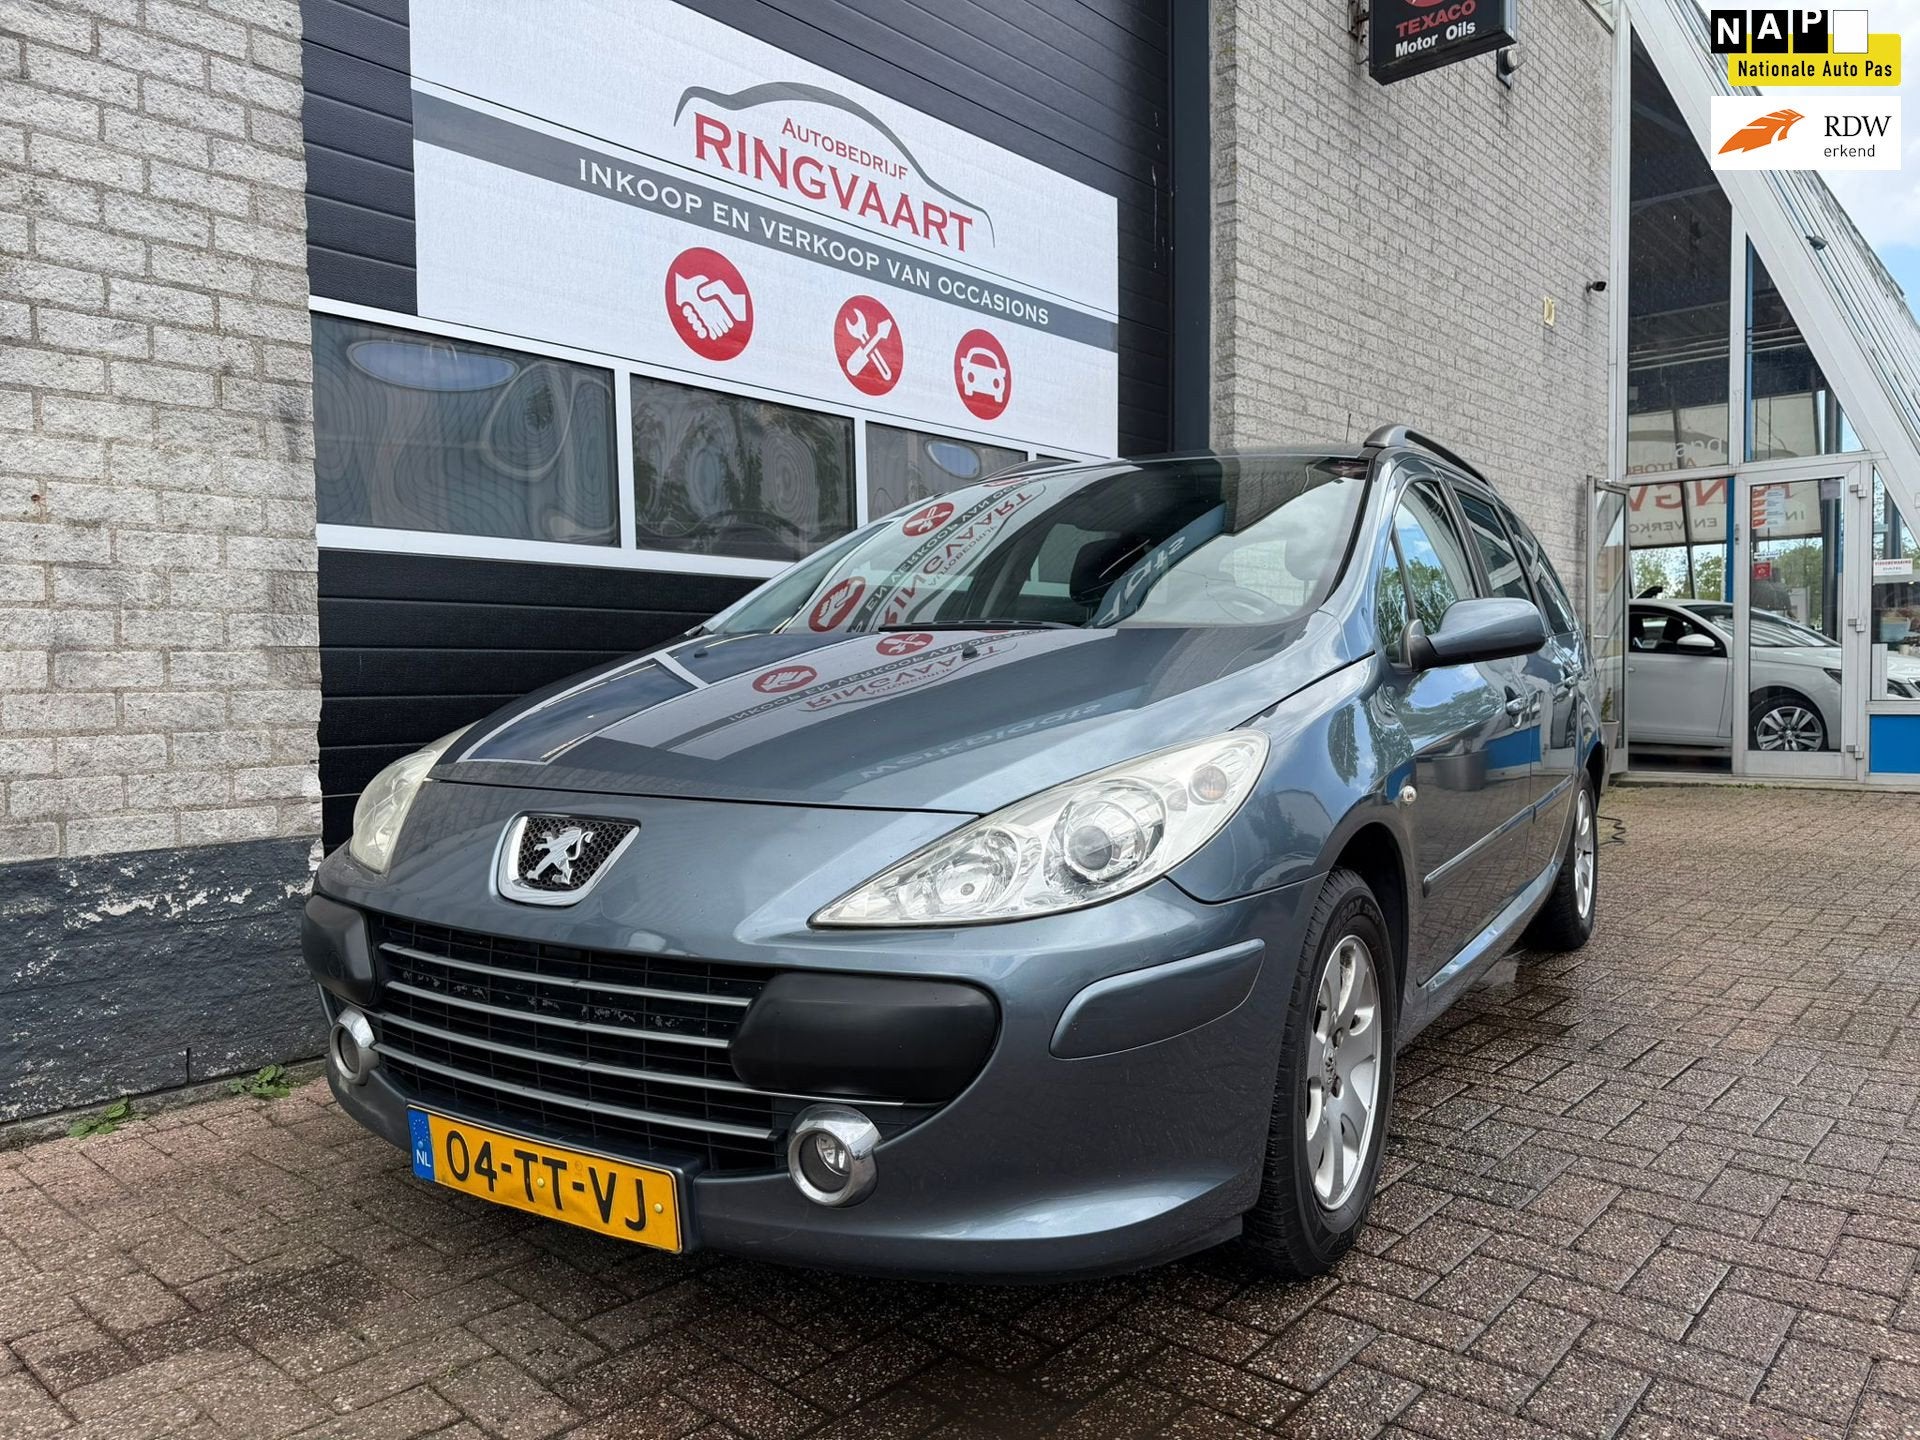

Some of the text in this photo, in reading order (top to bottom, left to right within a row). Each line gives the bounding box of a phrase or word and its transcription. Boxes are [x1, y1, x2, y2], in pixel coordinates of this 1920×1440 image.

[1395, 21, 1476, 58] Motor Oils
[1396, 0, 1476, 37] TEXACO
[781, 118, 908, 180] AUTOBEDRIJF
[694, 112, 973, 252] RINGVAART
[579, 158, 1049, 326] INKOOP EN VERKOOP VAN OCCASIONS
[416, 1148, 432, 1168] NL
[446, 1129, 647, 1232] 04-TT-VJ
